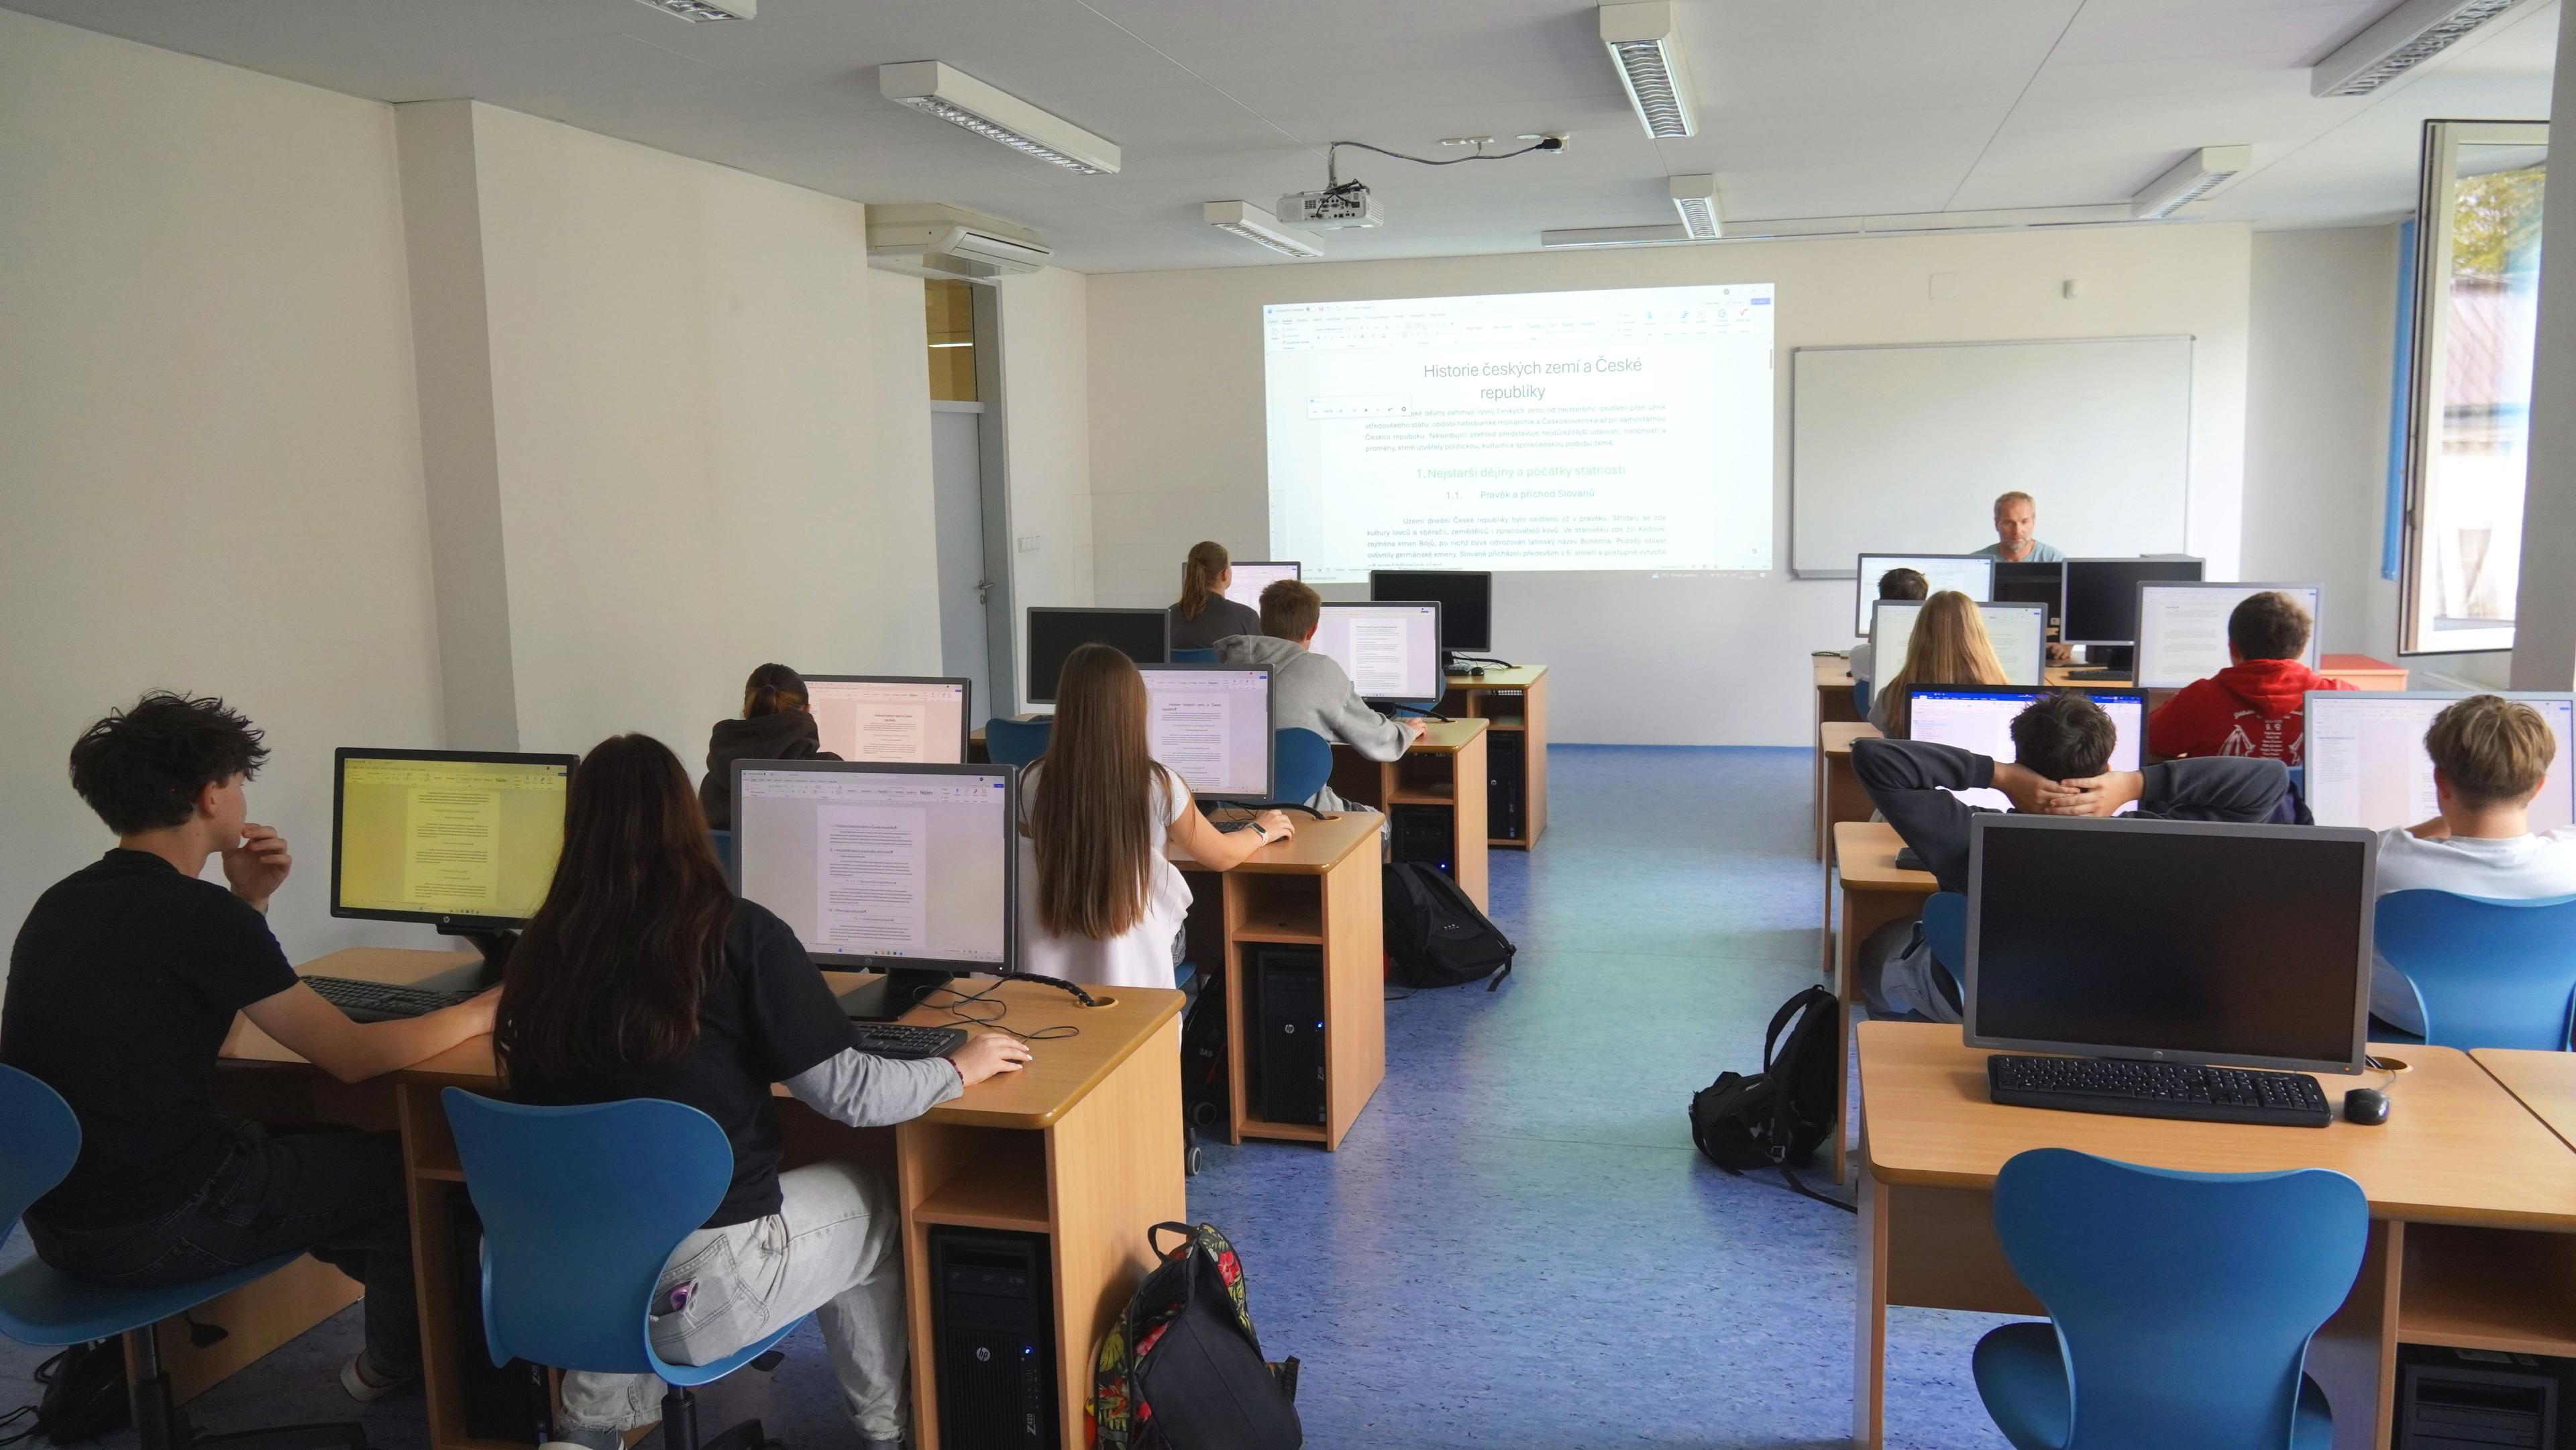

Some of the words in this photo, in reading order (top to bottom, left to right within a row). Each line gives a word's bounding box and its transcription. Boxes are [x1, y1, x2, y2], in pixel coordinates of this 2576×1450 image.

[1424, 363, 1479, 378] Historie
[1482, 360, 1541, 378] českých
[1545, 359, 1582, 374] zemí
[1582, 362, 1591, 372] a
[1595, 355, 1642, 372] České
[1481, 384, 1545, 401] republiky
[1428, 467, 1477, 480] Nejstarší
[1481, 466, 1514, 479] dějiny
[1517, 468, 1523, 477] a
[1526, 465, 1572, 479] počátky
[1574, 464, 1625, 476] státnosti
[1446, 491, 1462, 499] 1.1.
[1480, 490, 1511, 499] Pravěk
[1521, 488, 1555, 499] příchod
[1558, 488, 1595, 498] Slovanů
[1285, 1024, 1294, 1034] hp
[977, 1347, 990, 1362] hp
[1026, 1413, 1036, 1436] Z420
